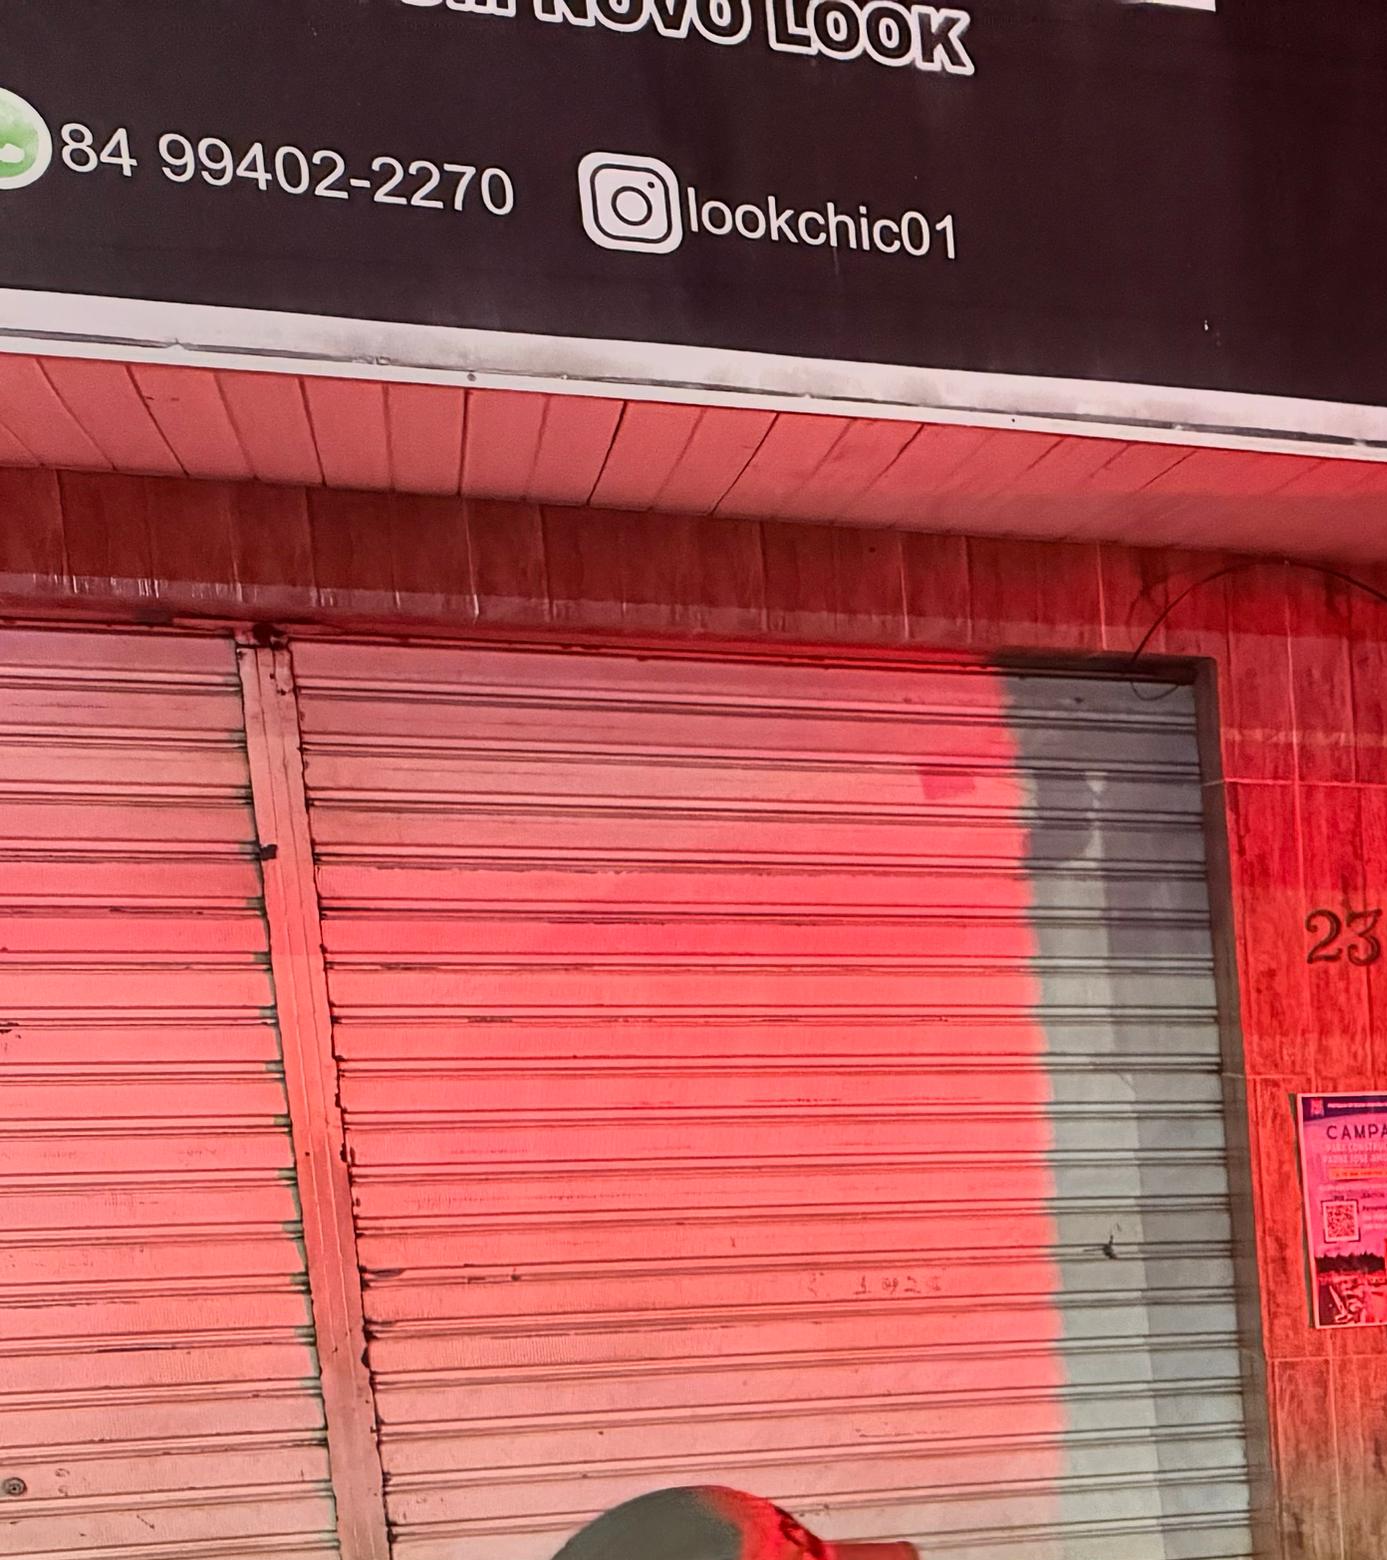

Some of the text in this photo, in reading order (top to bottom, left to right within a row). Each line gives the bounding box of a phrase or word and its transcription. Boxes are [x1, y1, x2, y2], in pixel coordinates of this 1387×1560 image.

[768, 0, 975, 75] LOOK
[60, 124, 515, 216] 84 99402-2270
[687, 187, 958, 261] lookchic01
[1305, 907, 1382, 967] 23
